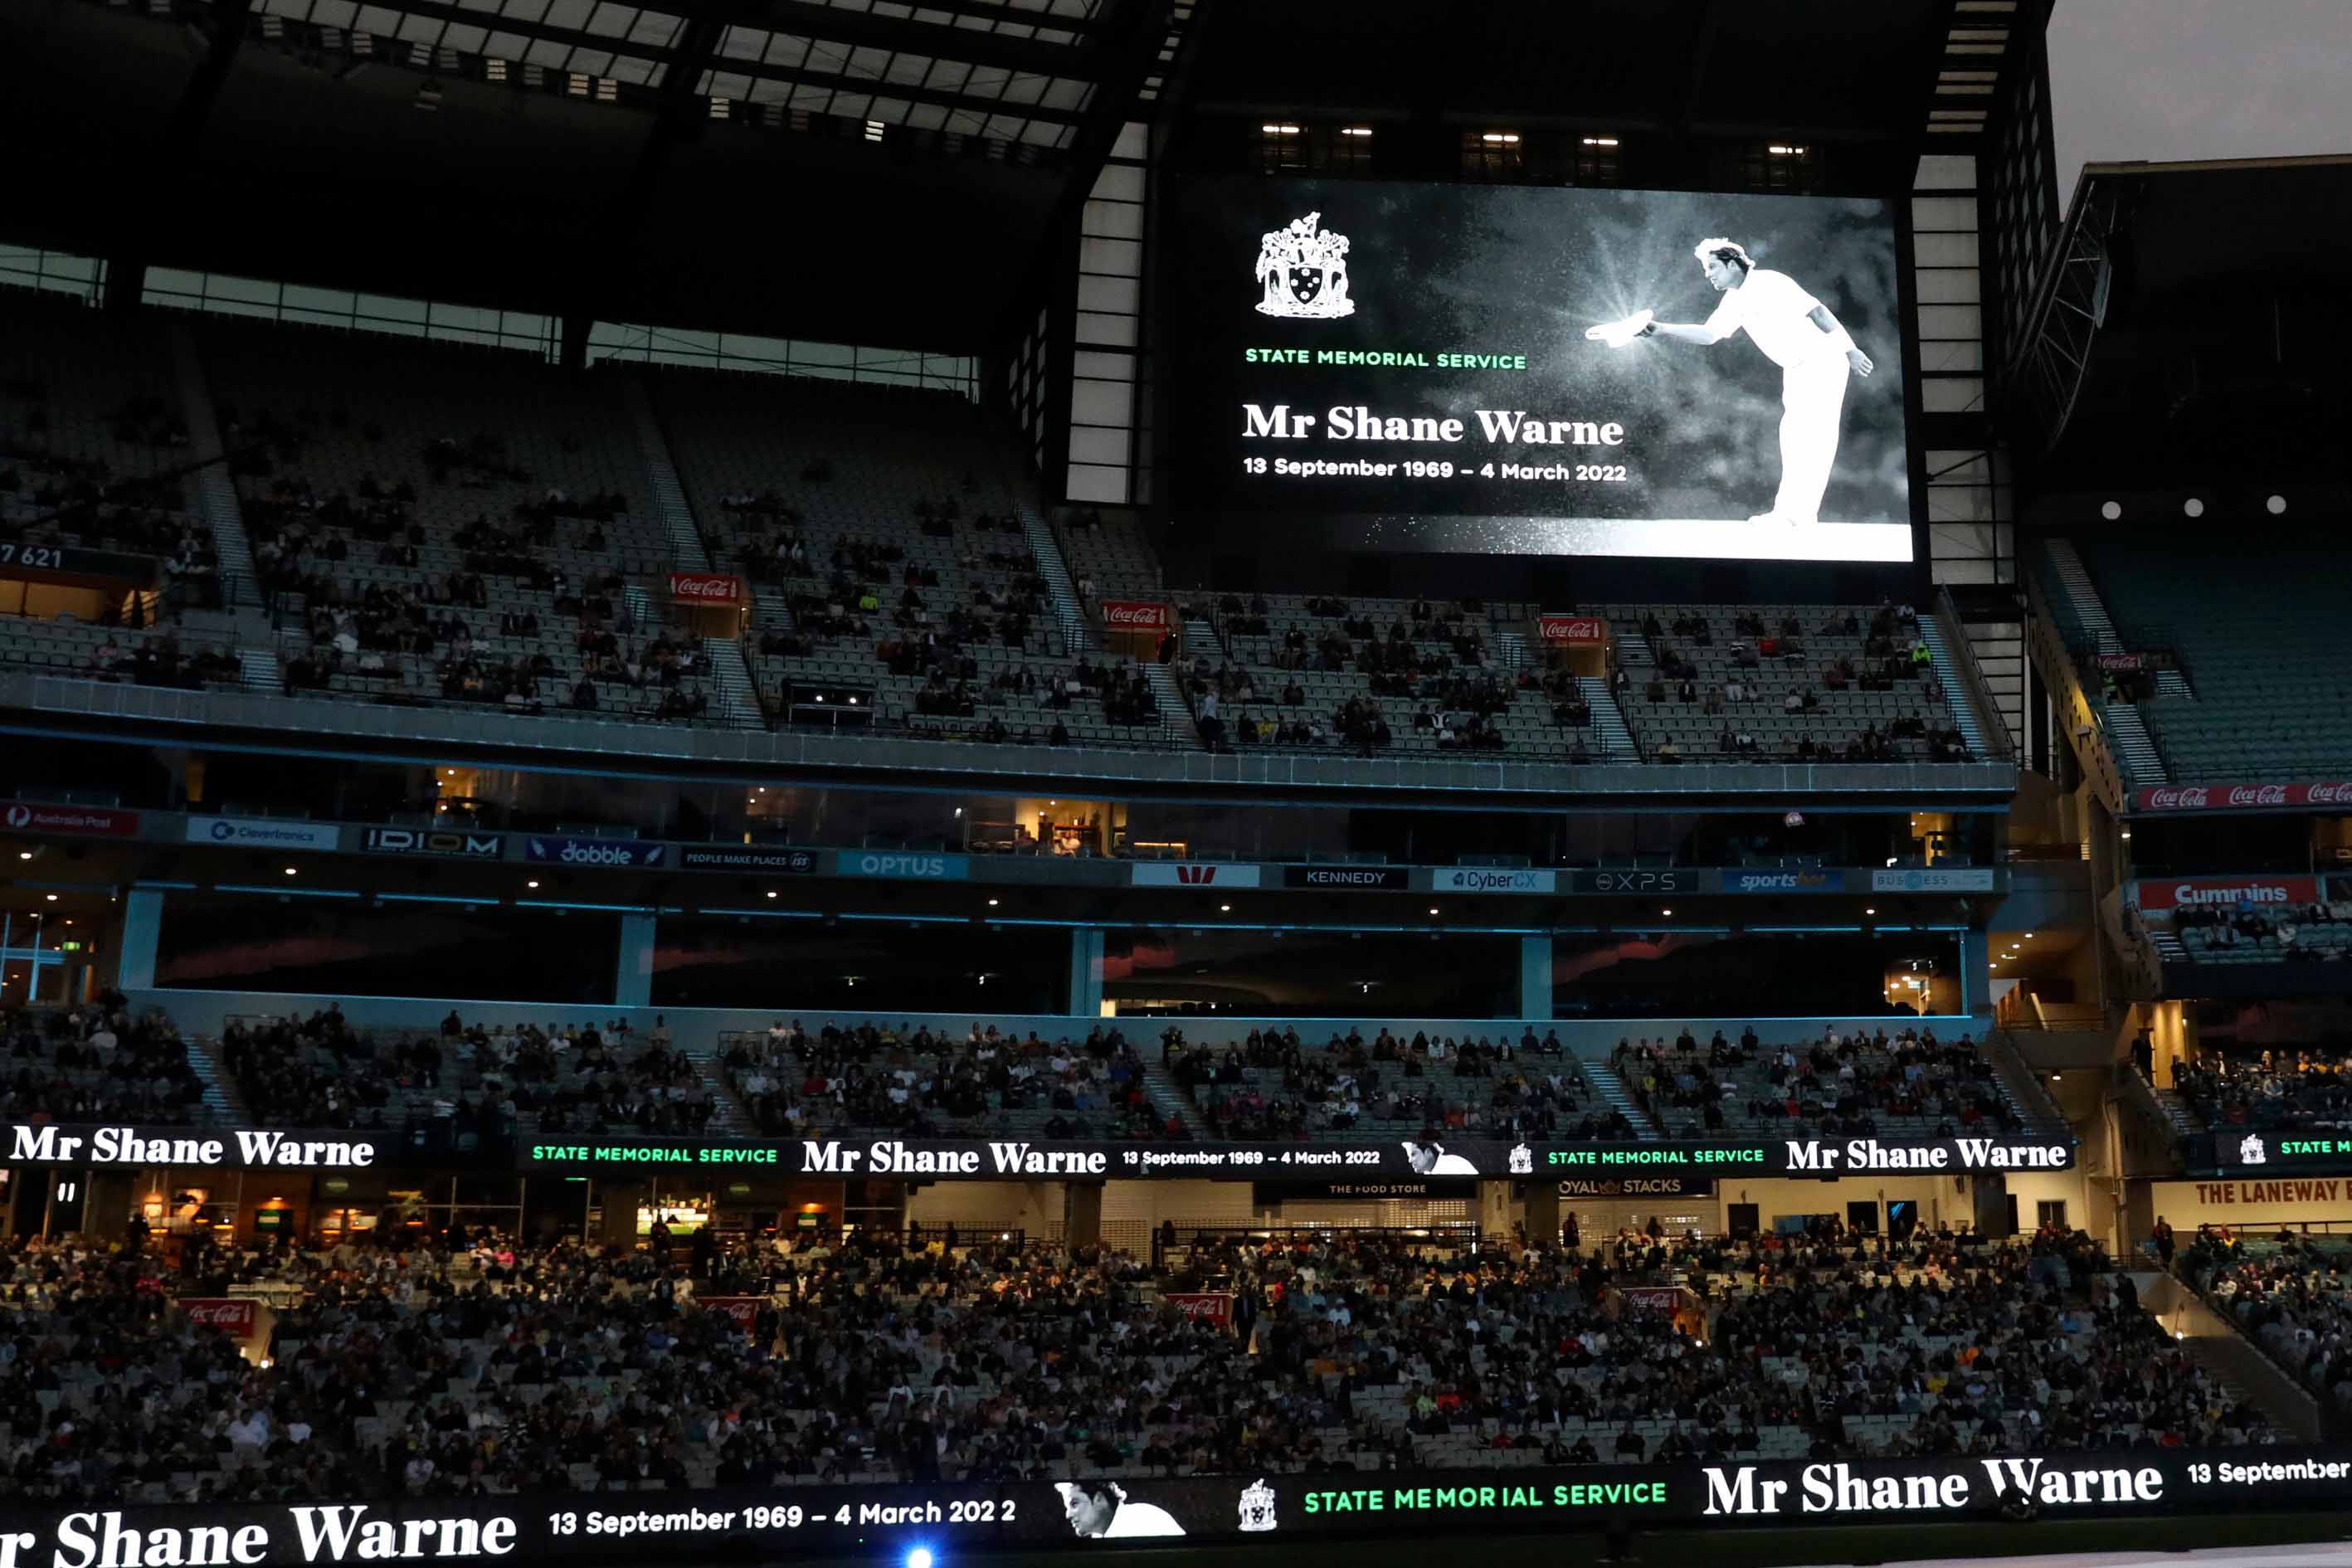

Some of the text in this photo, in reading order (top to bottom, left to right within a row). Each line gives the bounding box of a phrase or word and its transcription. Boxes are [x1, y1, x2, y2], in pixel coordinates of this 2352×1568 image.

[1245, 348, 1527, 370] STATE MEMORIAL SERVICE
[1241, 404, 1624, 446] Mr Shane Warne
[1243, 457, 1268, 475] 13
[1273, 458, 1397, 479] September
[1402, 461, 1454, 479] 1969
[1479, 462, 1496, 479] 4
[1501, 462, 1570, 480] March
[1575, 464, 1627, 482] 2022
[21, 547, 62, 569] 621
[677, 578, 728, 597] Coca-Cola
[1110, 606, 1157, 622] Coca-Cola
[1546, 622, 1592, 637] Coca-Cola
[2150, 787, 2208, 807] Coca-Cola
[2230, 784, 2287, 805] Coca-Cola
[2307, 782, 2352, 802] Coca-Co
[368, 829, 499, 853] IDIOM
[561, 839, 633, 864] dabble
[686, 853, 787, 866] PEOPLE MAKE PLACES
[860, 855, 945, 876] OPTUS
[1307, 871, 1386, 884] KENNEDY
[1467, 871, 1537, 891] CyberCX
[2175, 884, 2287, 904] Cummins
[8, 1125, 375, 1166] Mr Shane Warne
[532, 1145, 777, 1163] STATE MEMORIAL SERVICE
[1785, 1138, 2067, 1170] Mr Shane Warne
[2281, 1140, 2352, 1154] STATE M
[801, 1141, 1107, 1174] Mr Shane Warne
[1122, 1151, 1138, 1165] 13
[1142, 1151, 1225, 1167] September
[1228, 1151, 1264, 1165] 1969
[1280, 1151, 1292, 1165] 4
[1294, 1151, 1342, 1165] March
[1345, 1151, 1381, 1165] 2022
[1548, 1149, 1765, 1165] STATE MEMORIAL SERVICE
[1329, 1185, 1427, 1195] THE FOOD STORE
[1559, 1178, 1682, 1195] OYAL STACKS
[2196, 1184, 2234, 1204] THE
[2241, 1181, 2338, 1203] LANEWAY
[2187, 1458, 2351, 1486] 13 September
[1702, 1458, 2164, 1515] Mr Shane Warne
[1304, 1482, 1667, 1513] STATE MEMORIAL SERVICE
[548, 1512, 577, 1535] 13
[586, 1507, 737, 1537] September
[741, 1505, 803, 1530] 1969
[834, 1504, 852, 1526] 4
[859, 1500, 942, 1526] March
[948, 1499, 1016, 1523] 2022
[52, 1511, 269, 1568] Shane
[289, 1505, 517, 1562] Warne
